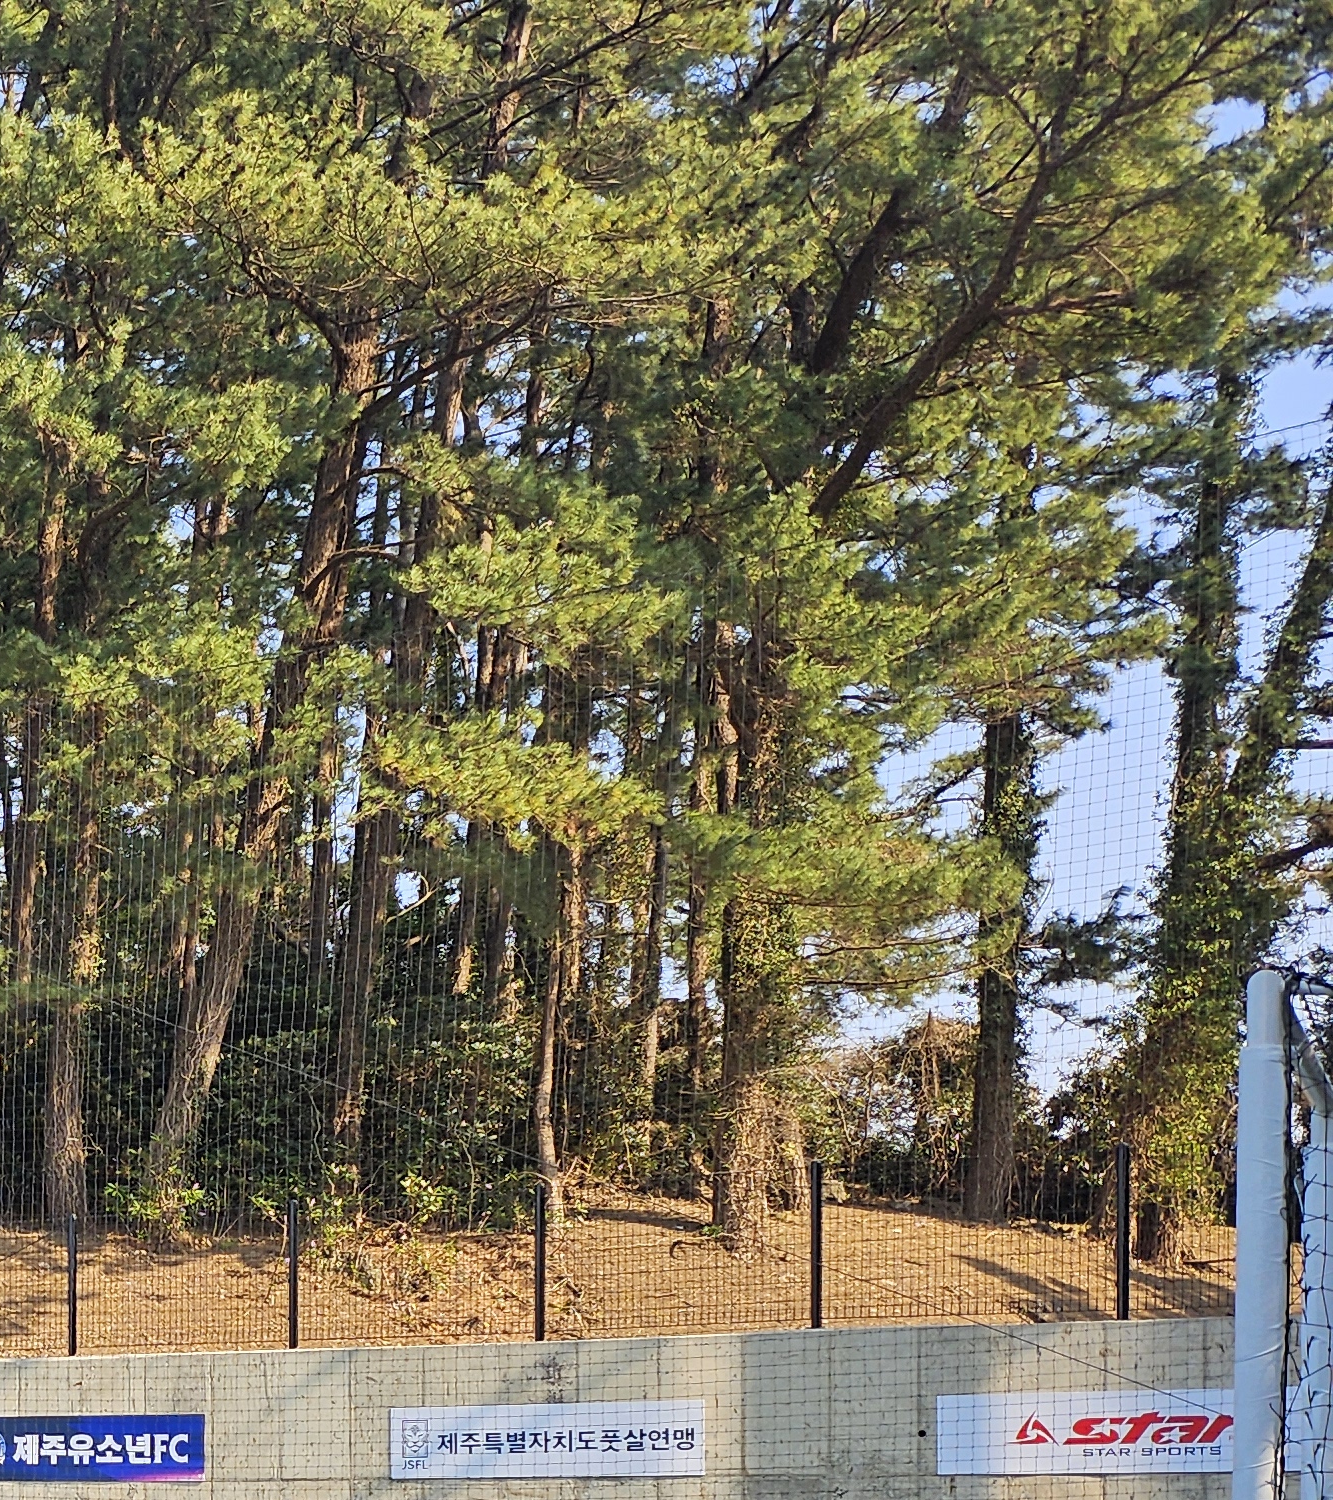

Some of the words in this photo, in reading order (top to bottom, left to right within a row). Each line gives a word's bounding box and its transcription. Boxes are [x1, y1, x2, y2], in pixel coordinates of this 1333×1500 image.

[12, 1432, 189, 1465] 제주유소년FC
[436, 1427, 696, 1456] 제주특별자치도풋살연맹
[1082, 1447, 1131, 1458] STAR
[1141, 1446, 1222, 1457] SPORTS
[402, 1460, 428, 1470] JSFL
